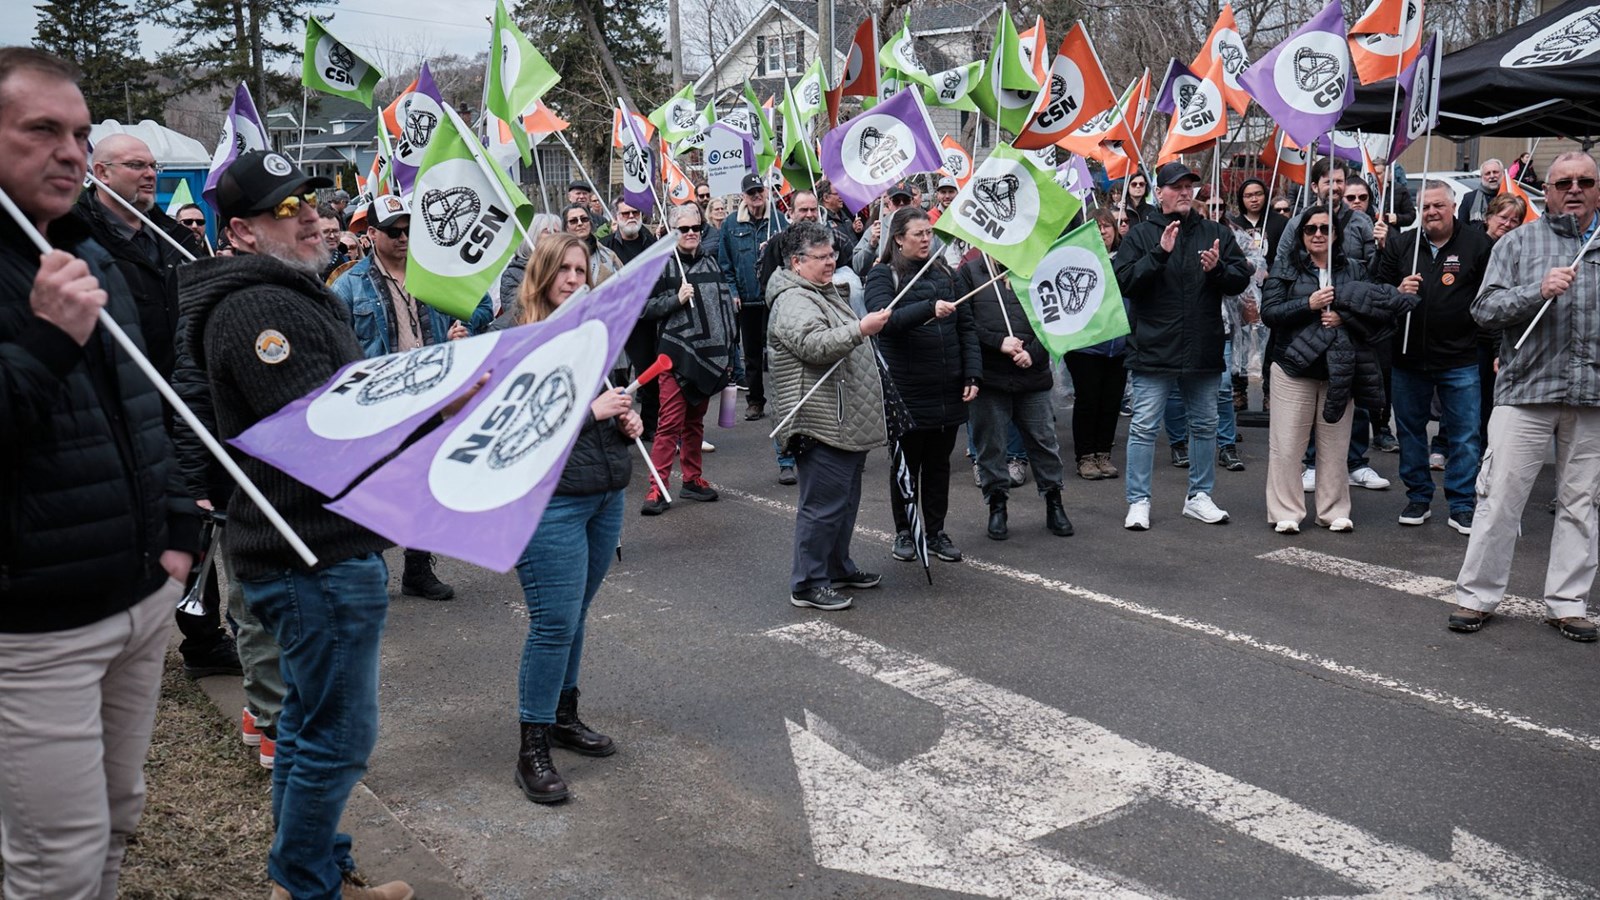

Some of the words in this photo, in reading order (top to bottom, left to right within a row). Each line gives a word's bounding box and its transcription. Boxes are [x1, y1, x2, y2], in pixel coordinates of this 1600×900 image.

[1512, 48, 1584, 66] CSN
[941, 89, 956, 99] CSN
[1313, 74, 1346, 108] CSN
[722, 117, 747, 131] CSN
[1037, 95, 1077, 128] CSN
[1079, 119, 1095, 133] CS
[1181, 109, 1215, 131] CSN
[1411, 105, 1426, 133] CSN
[722, 149, 742, 160] CSQ
[869, 148, 908, 180] CSN
[459, 204, 509, 265] CSN
[959, 199, 1005, 240] CSN
[1037, 280, 1061, 324] CSN
[446, 372, 536, 465] CSN
